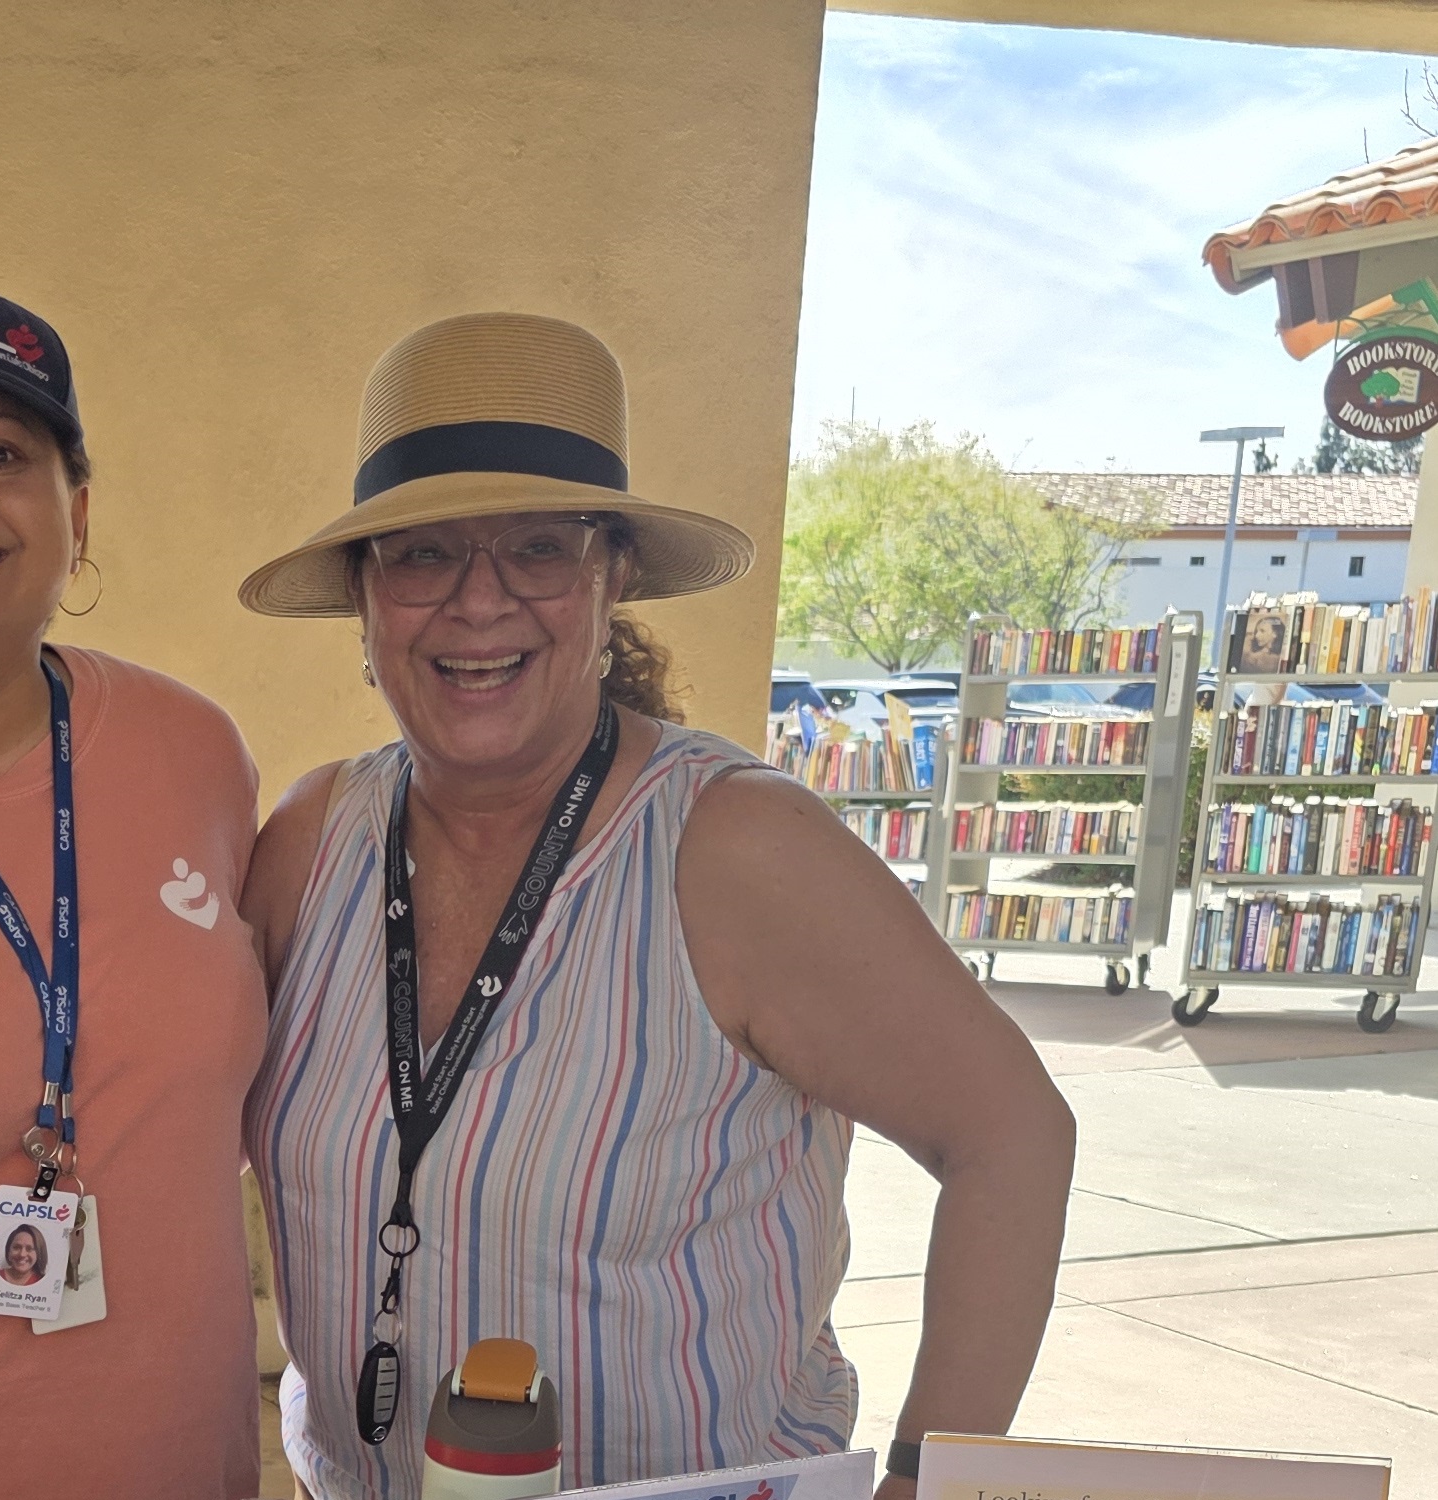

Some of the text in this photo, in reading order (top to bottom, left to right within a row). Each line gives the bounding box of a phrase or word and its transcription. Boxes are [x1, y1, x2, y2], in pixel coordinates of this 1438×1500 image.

[1339, 401, 1438, 433] BOOKSTORE
[518, 773, 593, 911] COUNT ON ME!
[25, 1293, 47, 1303] Ryan
